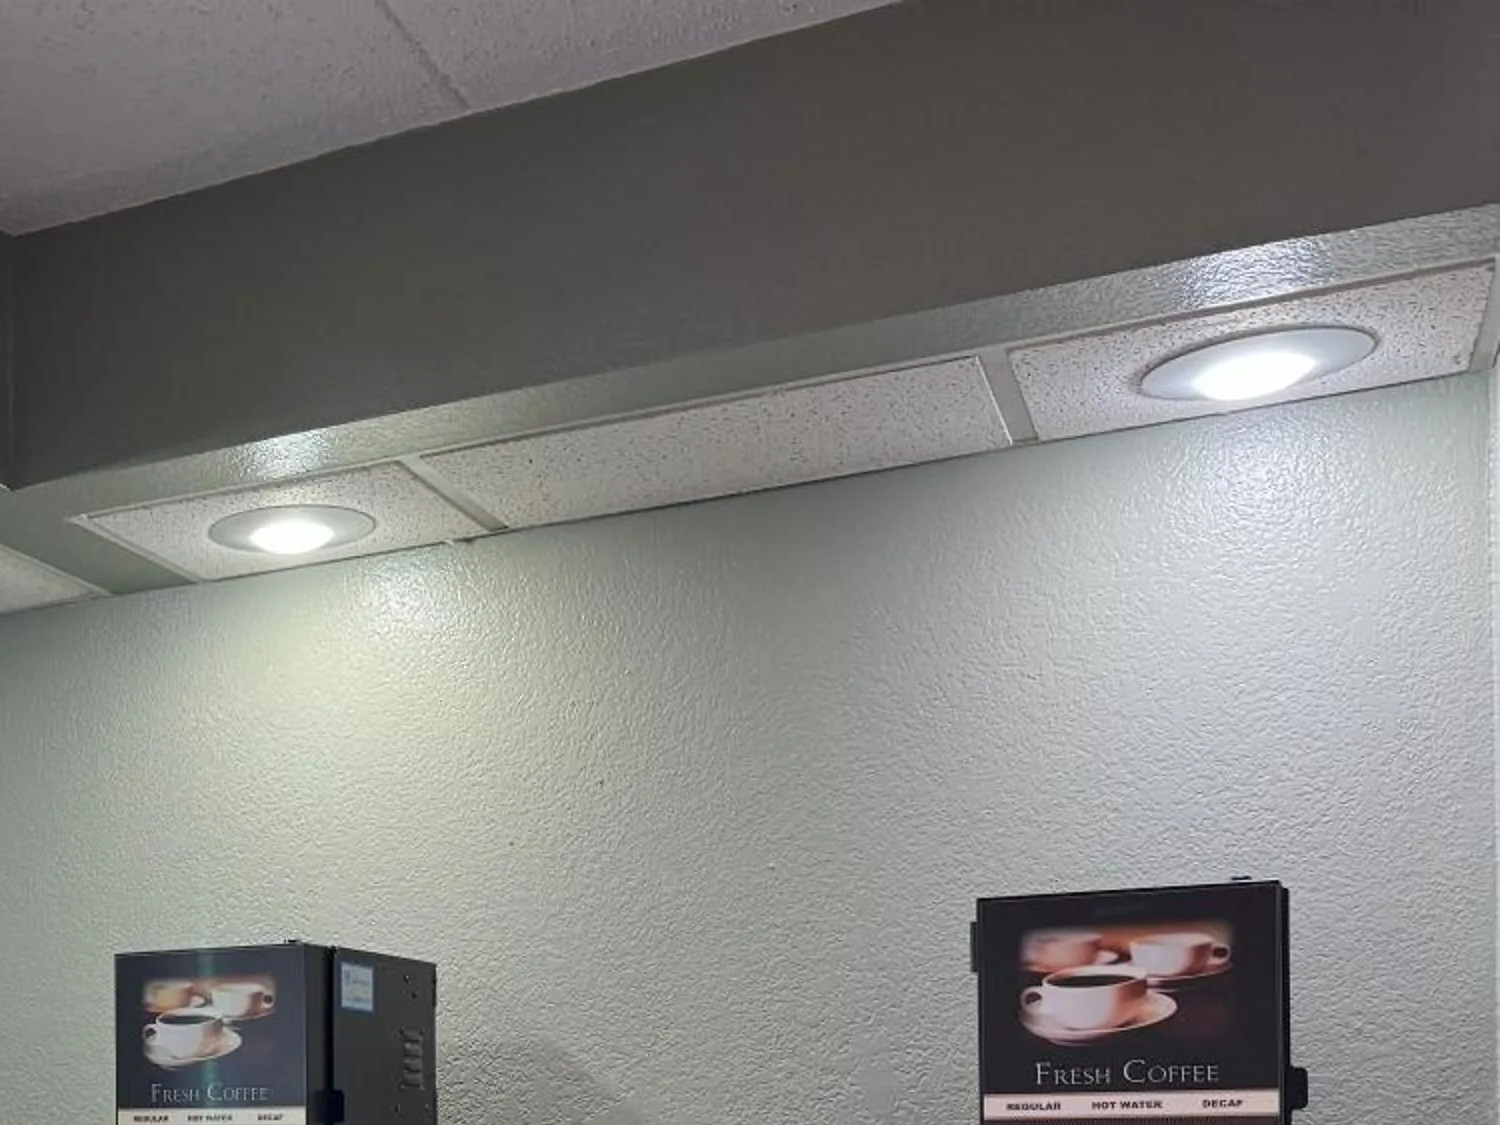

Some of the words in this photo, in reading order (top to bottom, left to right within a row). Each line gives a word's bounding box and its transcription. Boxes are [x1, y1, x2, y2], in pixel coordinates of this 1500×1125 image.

[1006, 1102, 1062, 1112] REGULAR
[1092, 1101, 1117, 1110] HOT
[1120, 1100, 1164, 1110] WATER
[1202, 1098, 1244, 1108] DECAF
